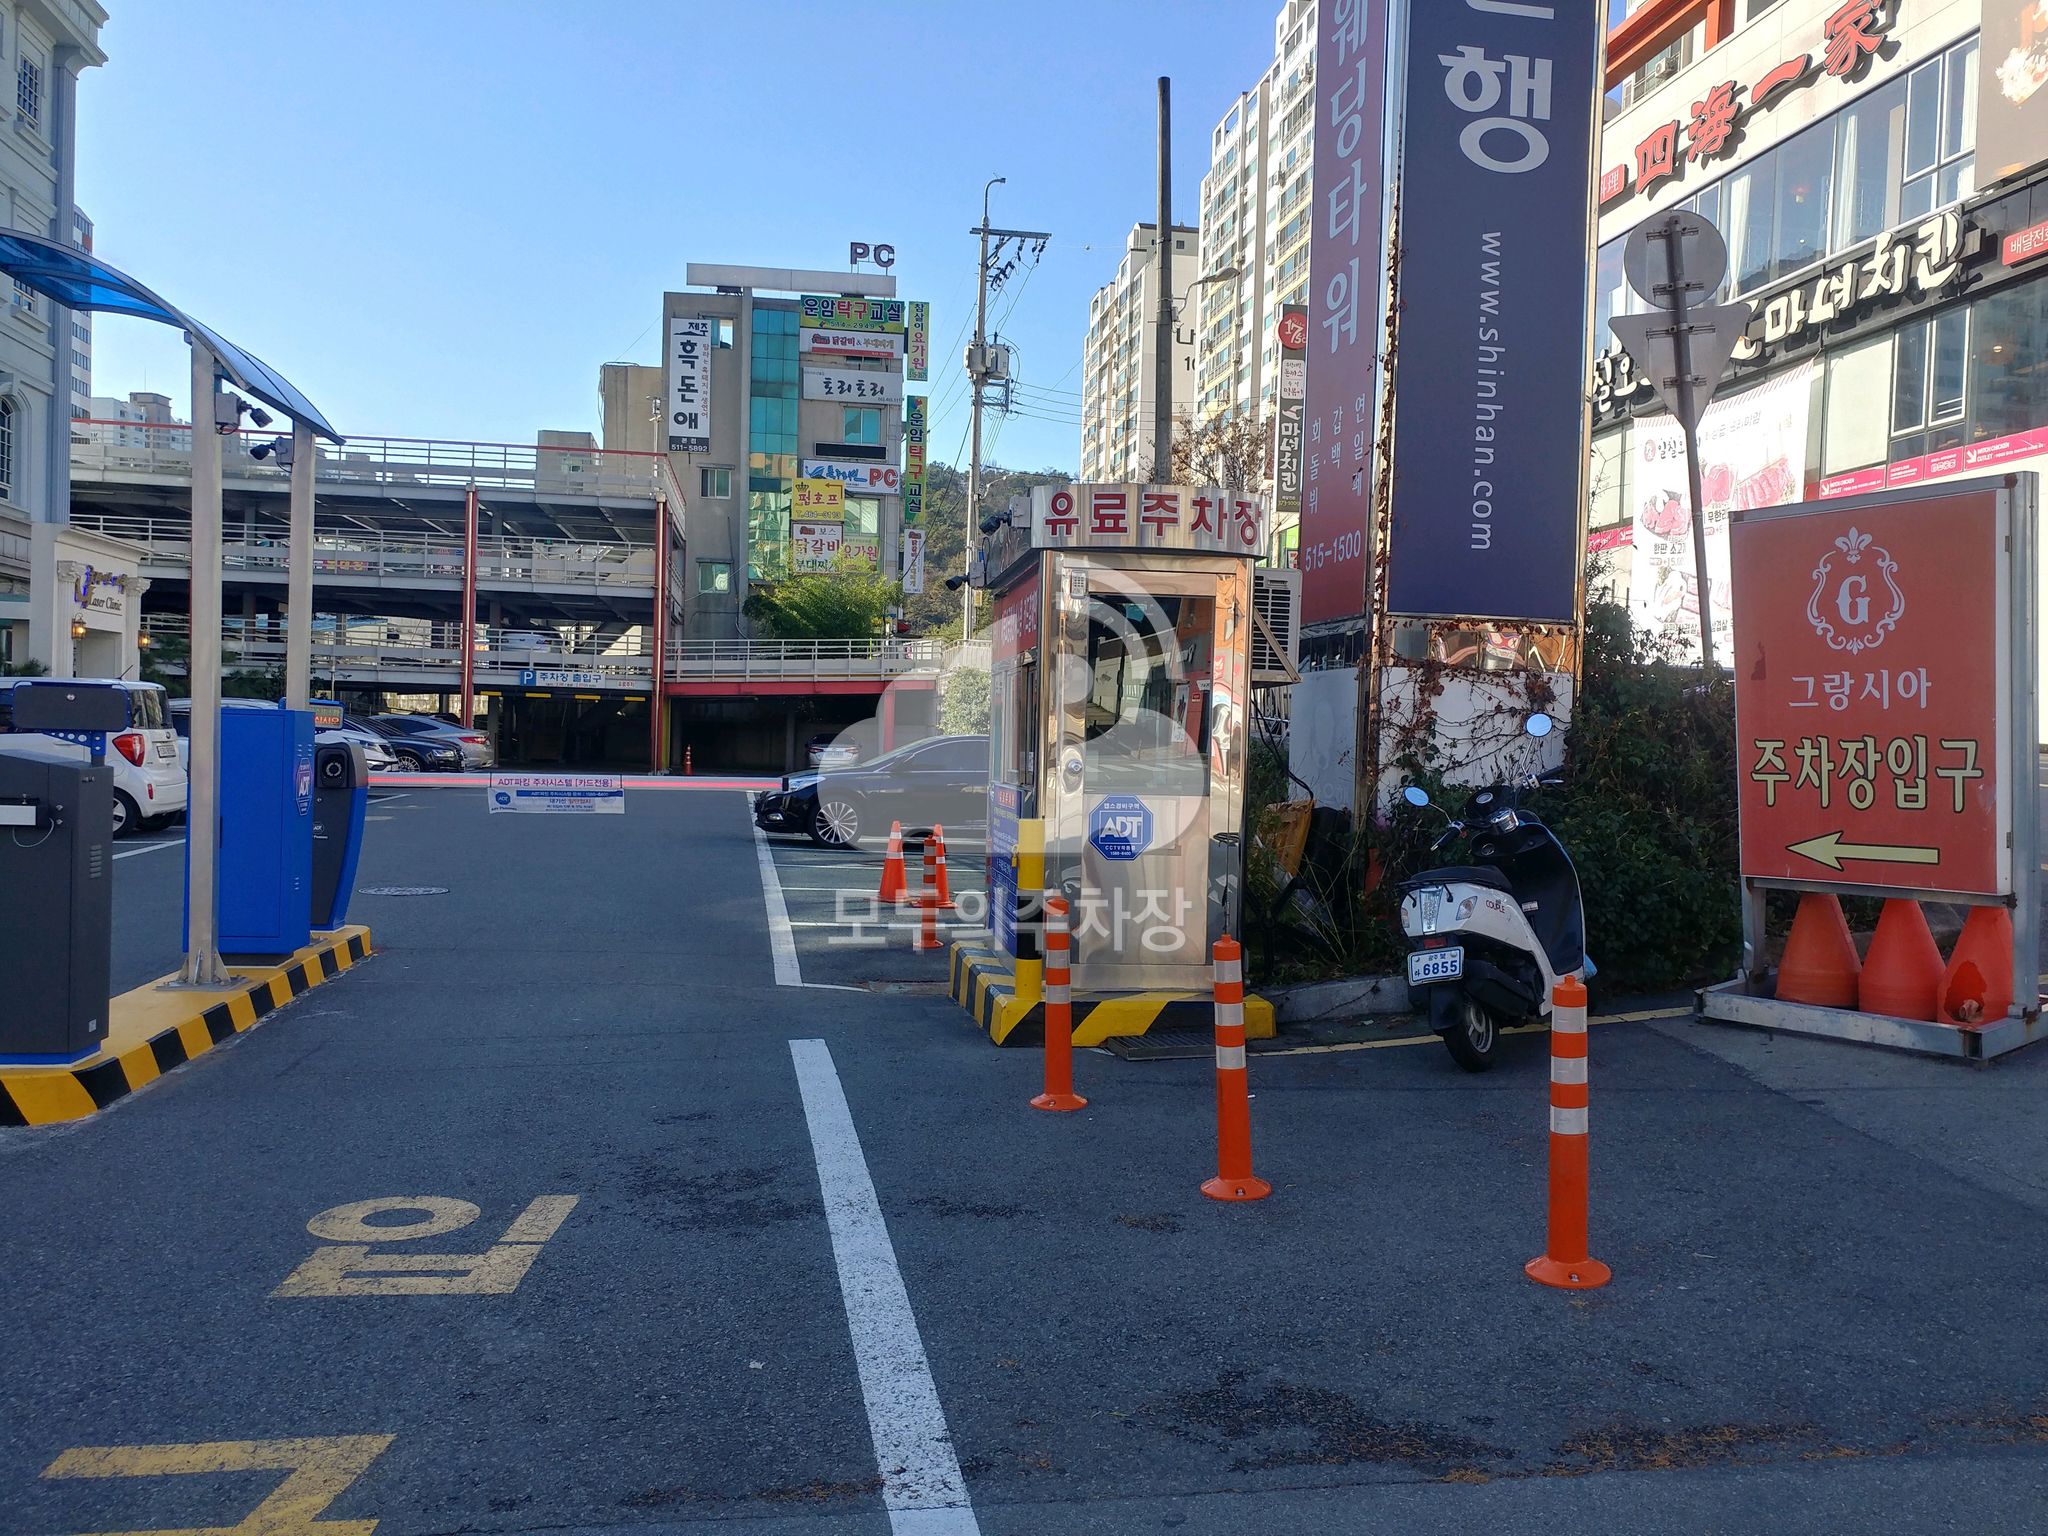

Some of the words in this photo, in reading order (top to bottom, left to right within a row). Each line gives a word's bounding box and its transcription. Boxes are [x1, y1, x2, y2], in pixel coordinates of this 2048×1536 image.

[1437, 0, 1553, 174] 행
[1635, 0, 1884, 194] 四海一家
[850, 242, 895, 267] PC
[1765, 211, 1964, 343] 마녀치킨
[688, 322, 709, 336] 제주
[804, 298, 902, 322] 운암탁구교실
[673, 339, 699, 430] 흑돈애
[1470, 231, 1506, 551] www.shinhan.com
[671, 444, 708, 452] 511-5892
[908, 412, 924, 513] 운암탁구교실
[1280, 422, 1300, 492] 마녀치킨
[869, 467, 899, 488] PC
[1044, 490, 1262, 547] 유료주차장
[1305, 530, 1362, 572] 515-1500
[1835, 575, 1871, 625] G
[523, 671, 533, 684] P
[540, 672, 569, 682] 주차장
[1788, 667, 1932, 711] 그랑시아
[533, 778, 573, 787] 주차시스템
[1751, 735, 1983, 813] 주차장입구
[1100, 816, 1142, 838] ADT
[1423, 960, 1458, 976] 6855
